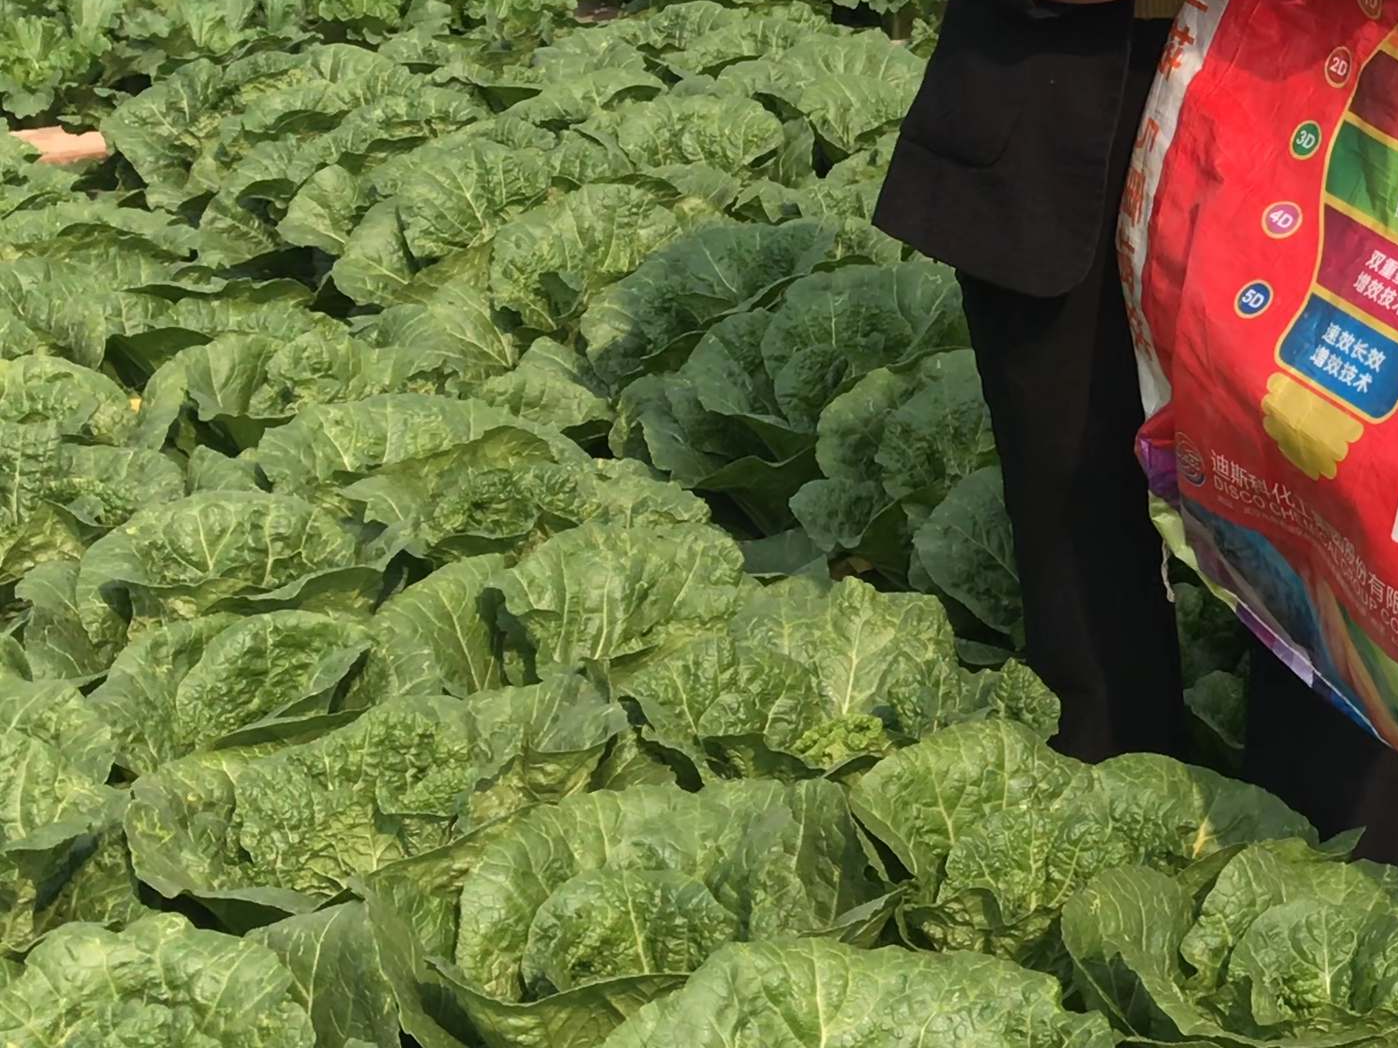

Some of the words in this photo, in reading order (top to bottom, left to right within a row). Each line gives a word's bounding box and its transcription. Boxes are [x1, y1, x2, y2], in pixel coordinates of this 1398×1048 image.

[1329, 56, 1348, 76] 2D
[1296, 130, 1316, 150] 3D
[1269, 209, 1293, 229] 4D
[1241, 289, 1265, 310] 5D
[1321, 321, 1386, 373] 速效长效
[1310, 345, 1373, 394] 增效技术
[1213, 474, 1265, 509] DISCO
